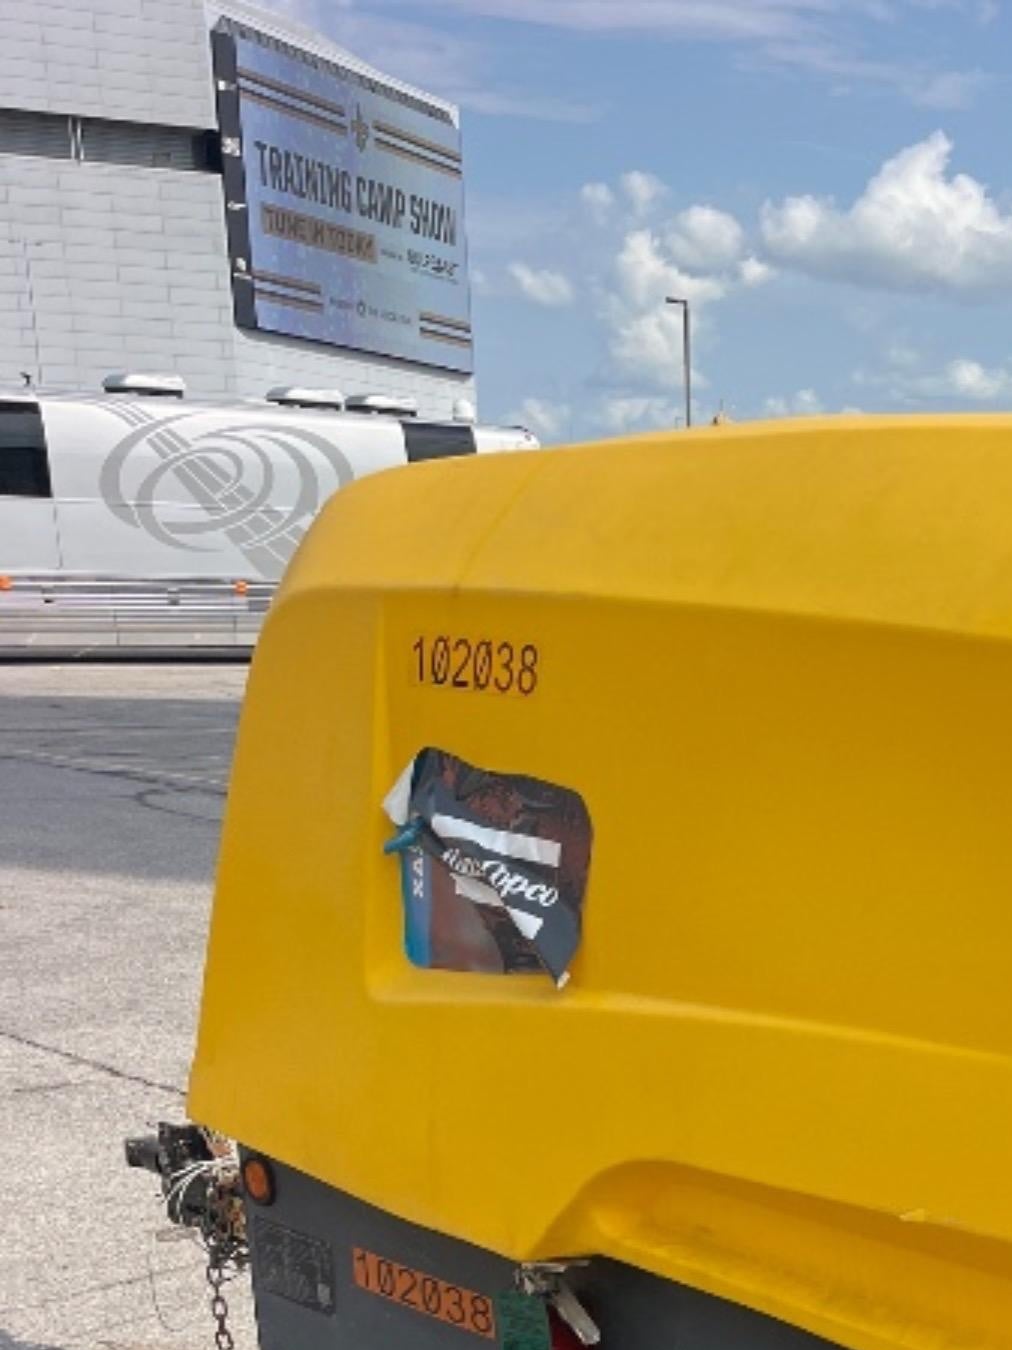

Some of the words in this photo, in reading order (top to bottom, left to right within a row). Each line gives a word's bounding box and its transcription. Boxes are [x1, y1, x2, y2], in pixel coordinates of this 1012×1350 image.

[254, 140, 352, 213] TRAINING
[356, 176, 405, 228] CAMP
[409, 194, 456, 247] SHOW
[412, 635, 539, 696] 102038
[356, 1249, 494, 1334] 102038
